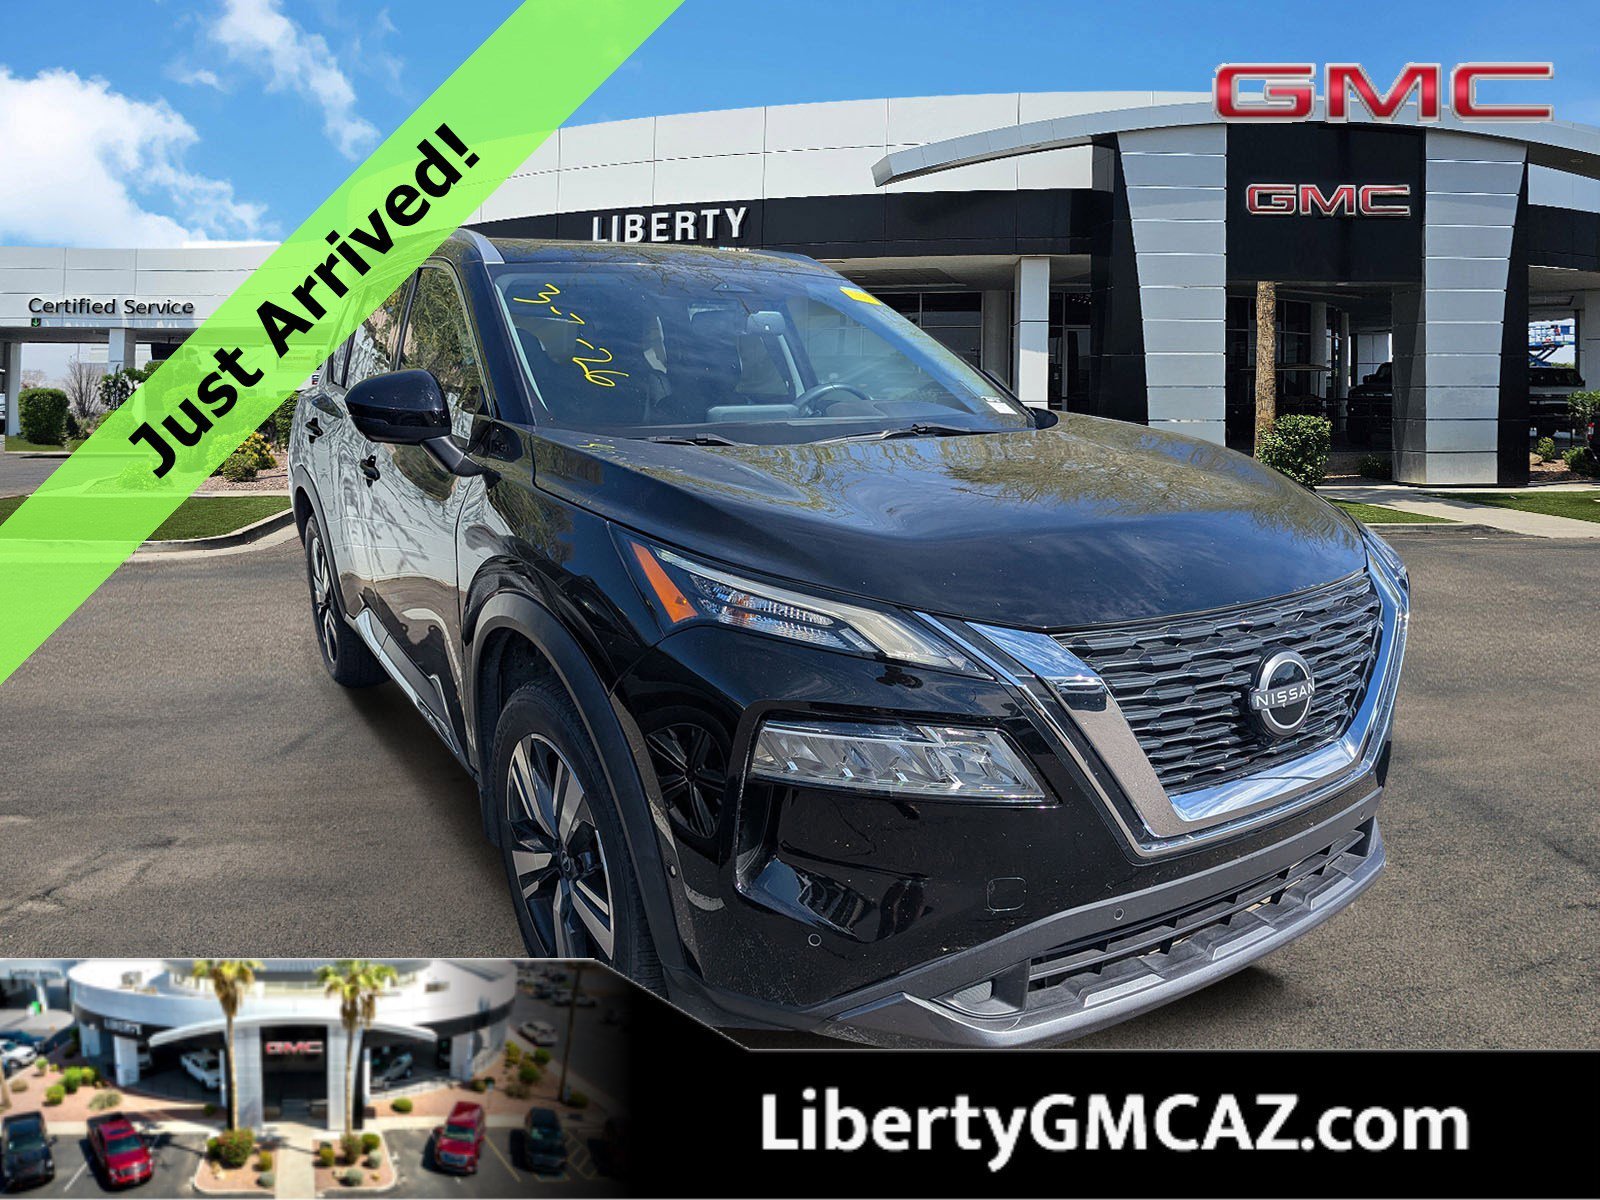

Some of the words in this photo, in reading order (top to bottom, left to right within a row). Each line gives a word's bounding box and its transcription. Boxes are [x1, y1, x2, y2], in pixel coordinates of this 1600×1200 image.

[1246, 184, 1411, 217] GMC
[592, 207, 747, 242] LIBERTY
[28, 297, 116, 315] Certified
[124, 299, 194, 315] Service
[1256, 683, 1315, 708] NISSAN
